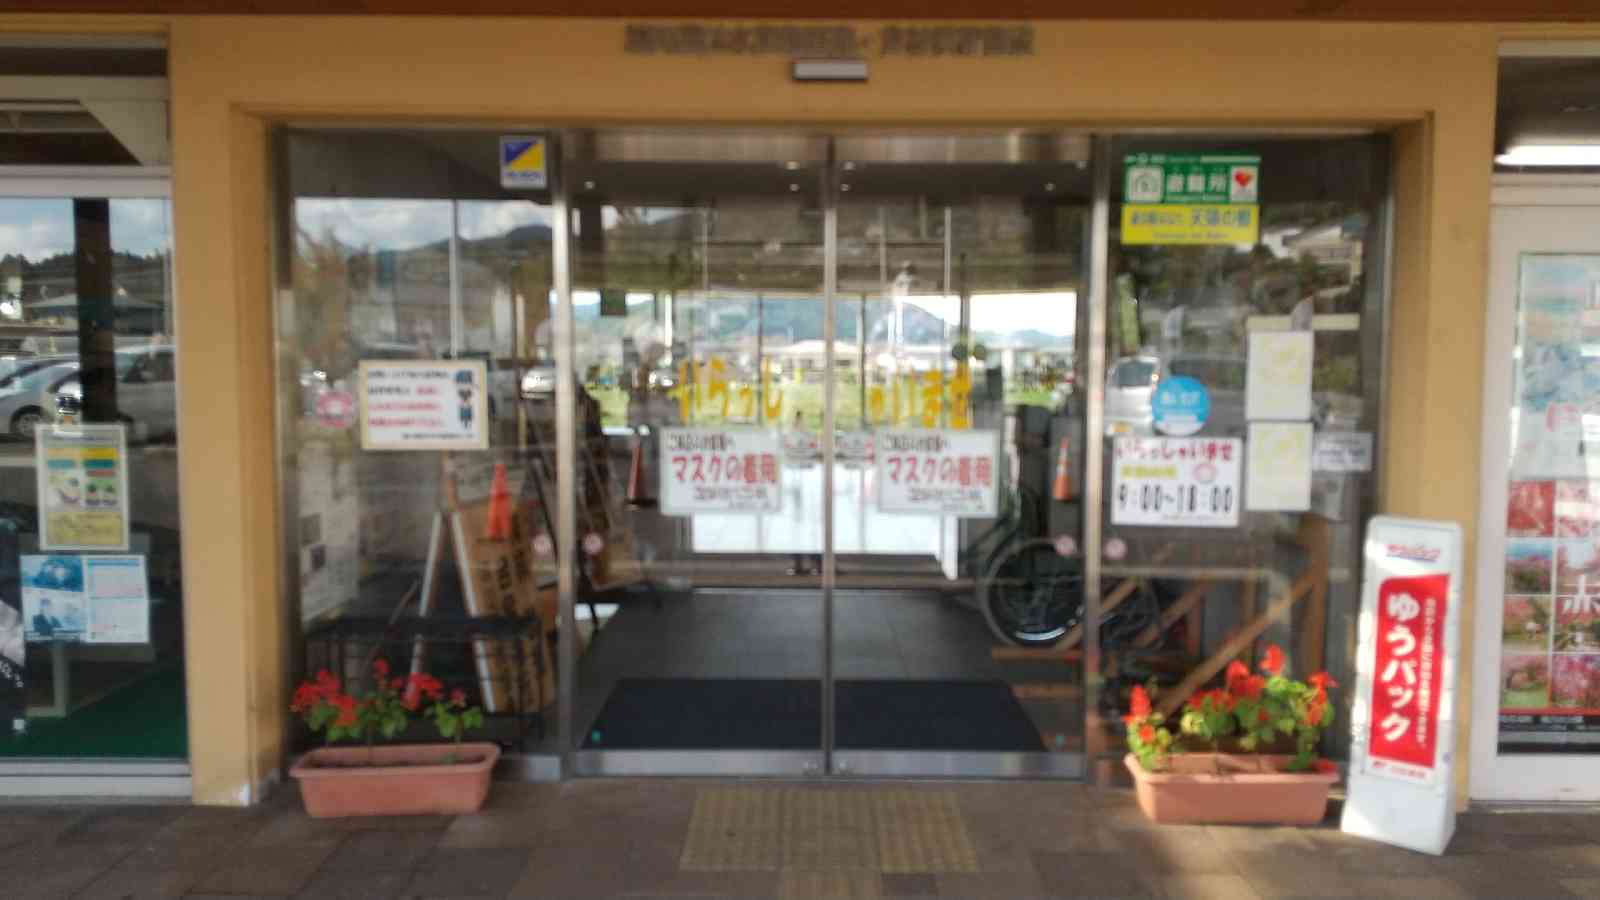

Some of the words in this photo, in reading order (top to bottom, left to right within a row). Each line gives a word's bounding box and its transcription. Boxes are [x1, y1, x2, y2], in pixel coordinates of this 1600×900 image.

[1380, 592, 1420, 743] ゆうパック
